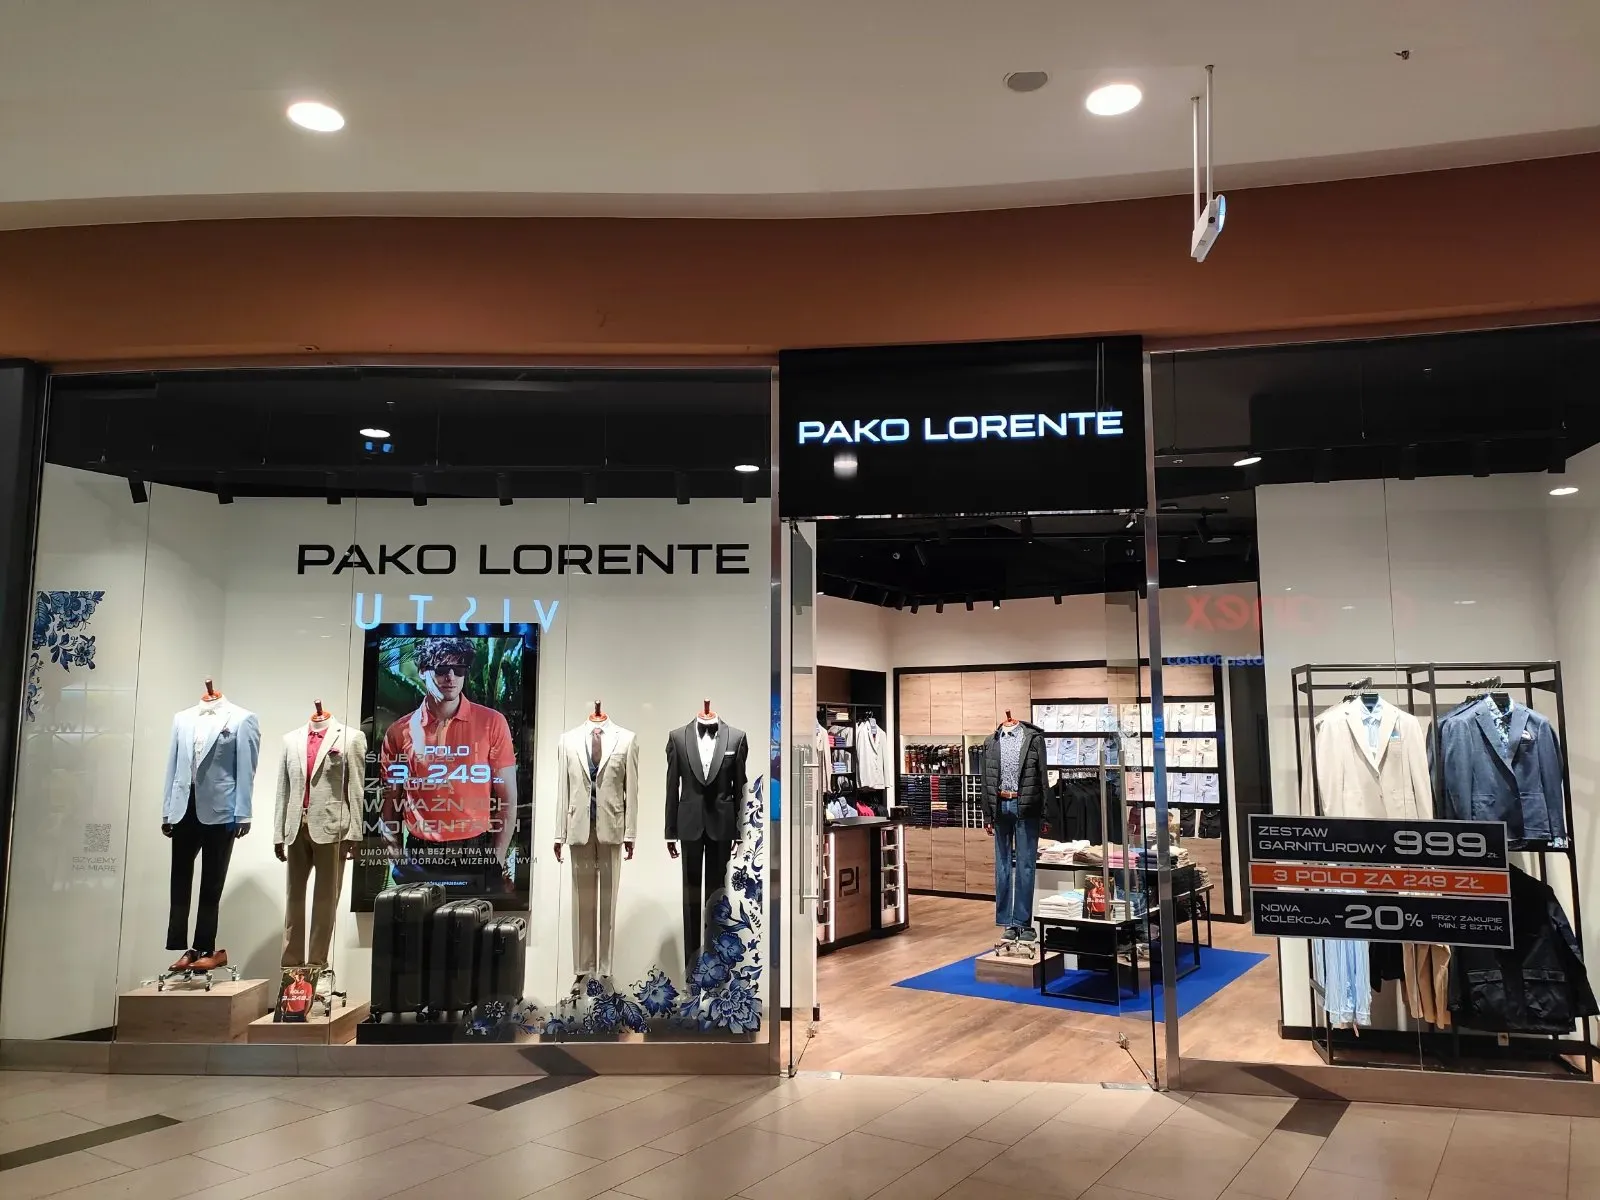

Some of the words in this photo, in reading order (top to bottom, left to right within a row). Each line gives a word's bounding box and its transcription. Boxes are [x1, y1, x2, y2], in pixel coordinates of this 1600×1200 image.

[798, 418, 909, 444] PAKO
[924, 411, 1124, 440] LORENTE
[297, 544, 457, 575] PAKO
[479, 543, 750, 575] LORENTE
[365, 750, 409, 763] ŚLUB
[424, 745, 470, 756] POLO
[387, 764, 409, 784] 3
[428, 764, 491, 784] 249
[363, 777, 380, 791] Z
[363, 798, 386, 812] W
[392, 795, 513, 812] WAŻNCH
[1258, 826, 1328, 838] ZESTAW
[428, 847, 482, 857] BEZPŁATNĄ
[1259, 840, 1387, 854] GARNITUROWY
[1393, 830, 1487, 857] 999
[411, 857, 457, 867] DORADCĄ
[1273, 869, 1288, 881] 3
[1295, 870, 1357, 884] POLO
[1363, 872, 1396, 886] ZA
[1403, 874, 1447, 888] 249
[1454, 876, 1484, 889] ZŁ
[1261, 903, 1301, 913] NOWA
[1460, 915, 1502, 923] ZAKUPIE
[1261, 914, 1331, 925] KOLEKCJA
[1469, 924, 1503, 932] SZTUK
